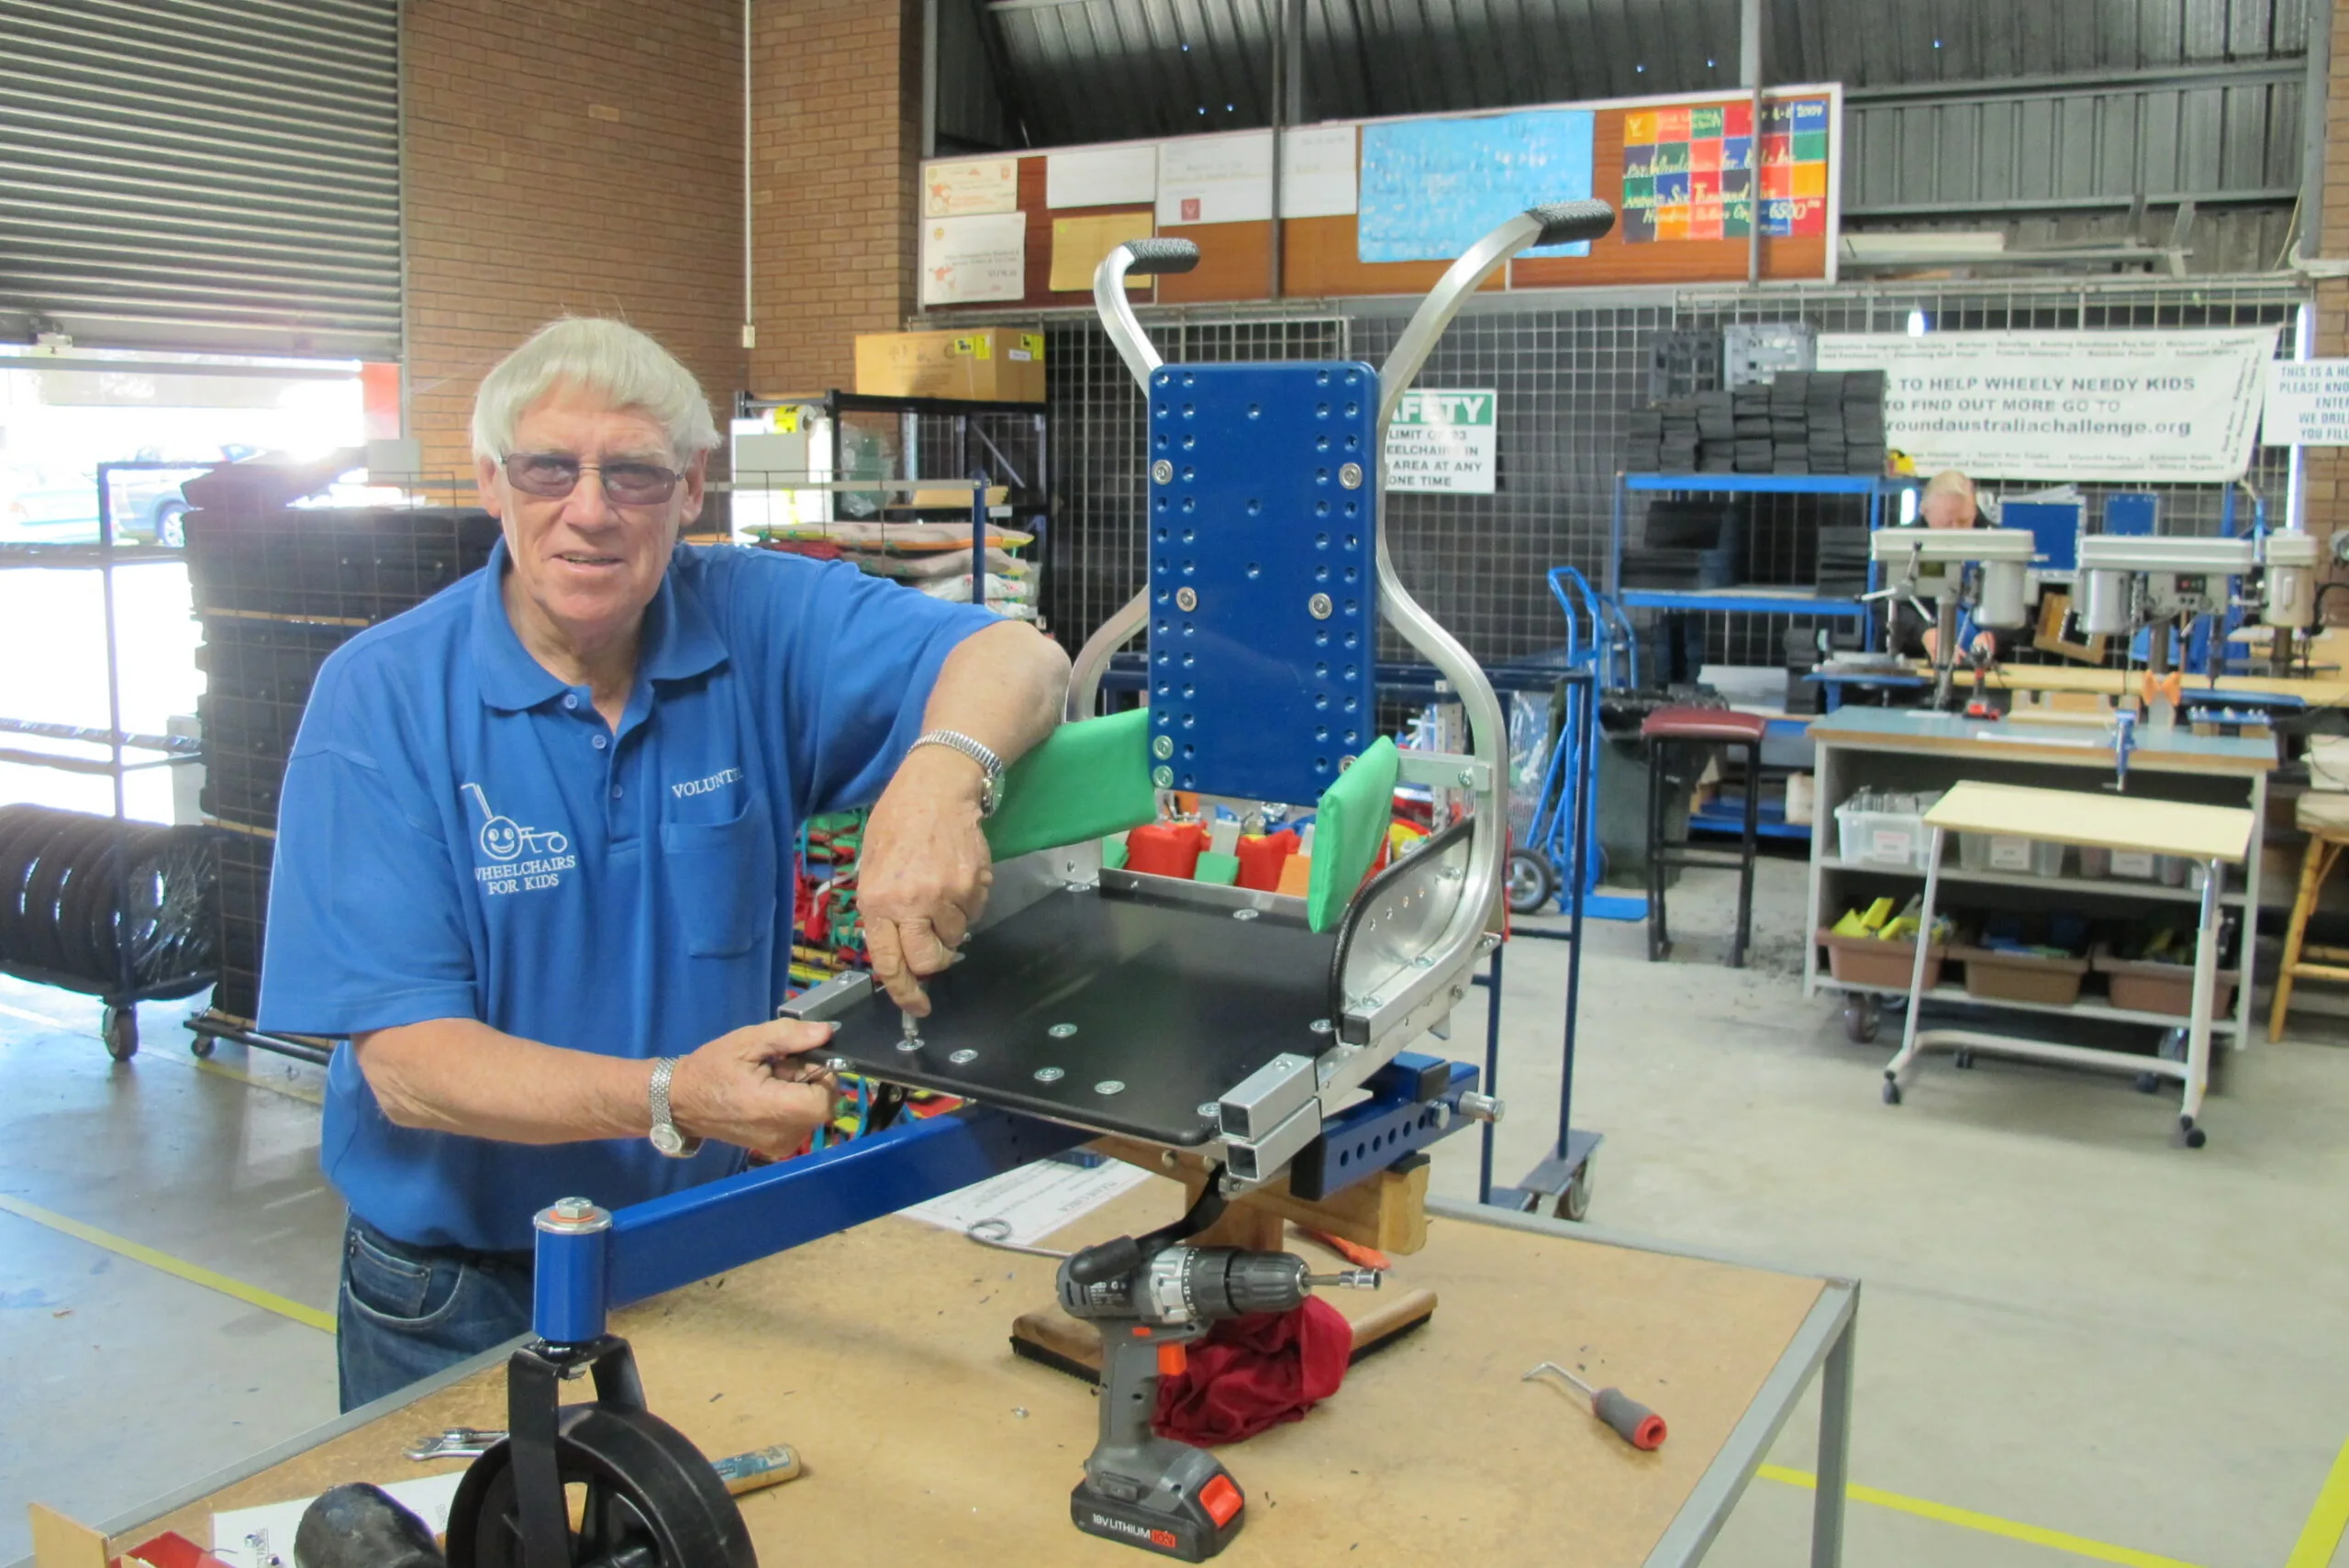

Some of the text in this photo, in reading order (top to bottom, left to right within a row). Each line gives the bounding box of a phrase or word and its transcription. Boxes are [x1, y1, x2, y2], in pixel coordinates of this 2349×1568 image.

[2281, 366, 2306, 377] THIS
[2310, 366, 2321, 377] IS
[2326, 366, 2332, 376] A
[1899, 378, 1922, 391] TO
[1930, 377, 1978, 391] HELP
[1985, 377, 2065, 391] WHEELY
[2072, 377, 2139, 392] NEEDY
[2146, 377, 2196, 391] KIDS
[2280, 383, 2319, 393] PLEASE
[1392, 396, 1485, 422] FETY
[1911, 399, 1953, 411] FIND
[1958, 399, 1997, 411] OUT
[2002, 399, 2055, 412] MORE
[2062, 399, 2089, 412] GO
[2095, 400, 2121, 413] TO
[2299, 413, 2316, 423] WE
[1885, 417, 2192, 438] roundaustraliachallenge.org
[1388, 430, 1422, 439] LIMIT
[2301, 428, 2321, 439] YOU
[1386, 446, 1478, 456] EELCHAI IN
[1393, 462, 1482, 472] AREA AT ANY
[1388, 477, 1452, 486] ONE TIME
[488, 873, 559, 895] FOR KIDS
[1092, 1513, 1108, 1527] 18V
[1110, 1518, 1151, 1539] LITHIUM
